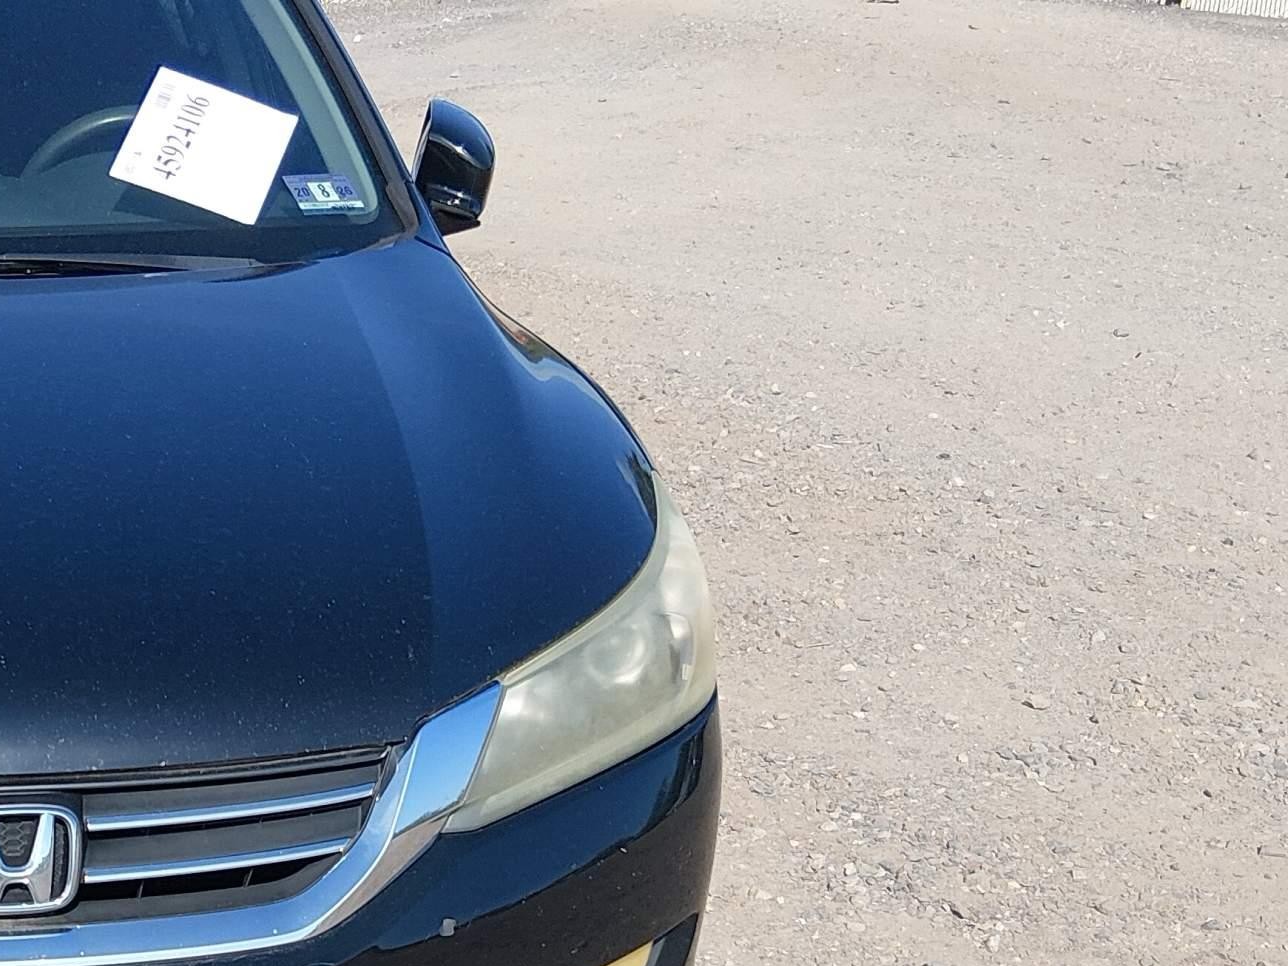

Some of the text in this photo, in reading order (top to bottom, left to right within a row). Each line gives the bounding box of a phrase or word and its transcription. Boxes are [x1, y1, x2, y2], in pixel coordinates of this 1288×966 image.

[153, 94, 210, 180] 45924106
[294, 187, 310, 198] 20
[317, 184, 330, 198] 8
